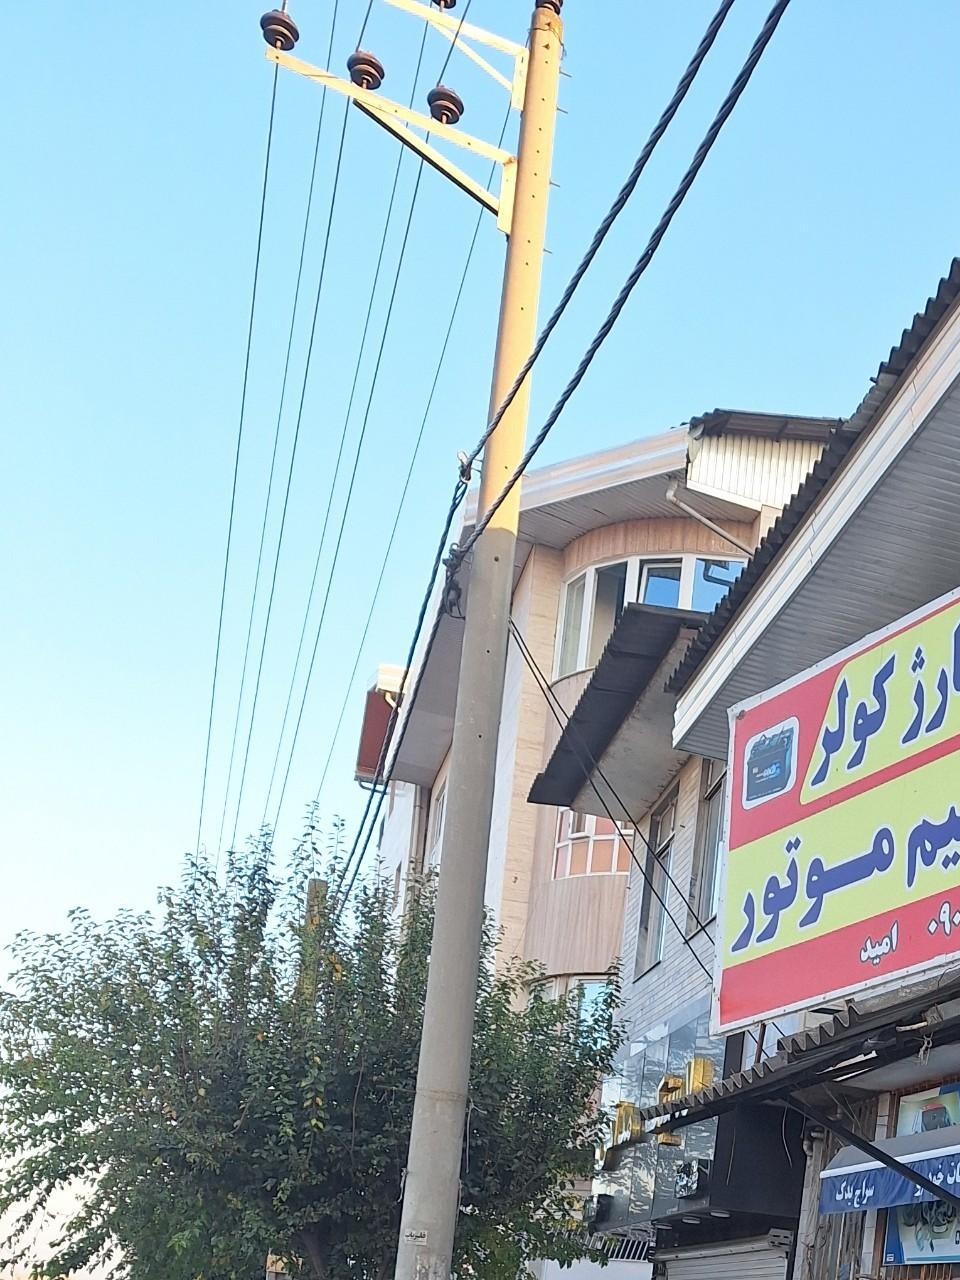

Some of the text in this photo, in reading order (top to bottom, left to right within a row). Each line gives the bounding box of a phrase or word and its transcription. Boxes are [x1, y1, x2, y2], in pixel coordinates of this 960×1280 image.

[811, 656, 896, 787] کولر
[731, 827, 895, 953] موتور
[859, 920, 899, 966] امید
